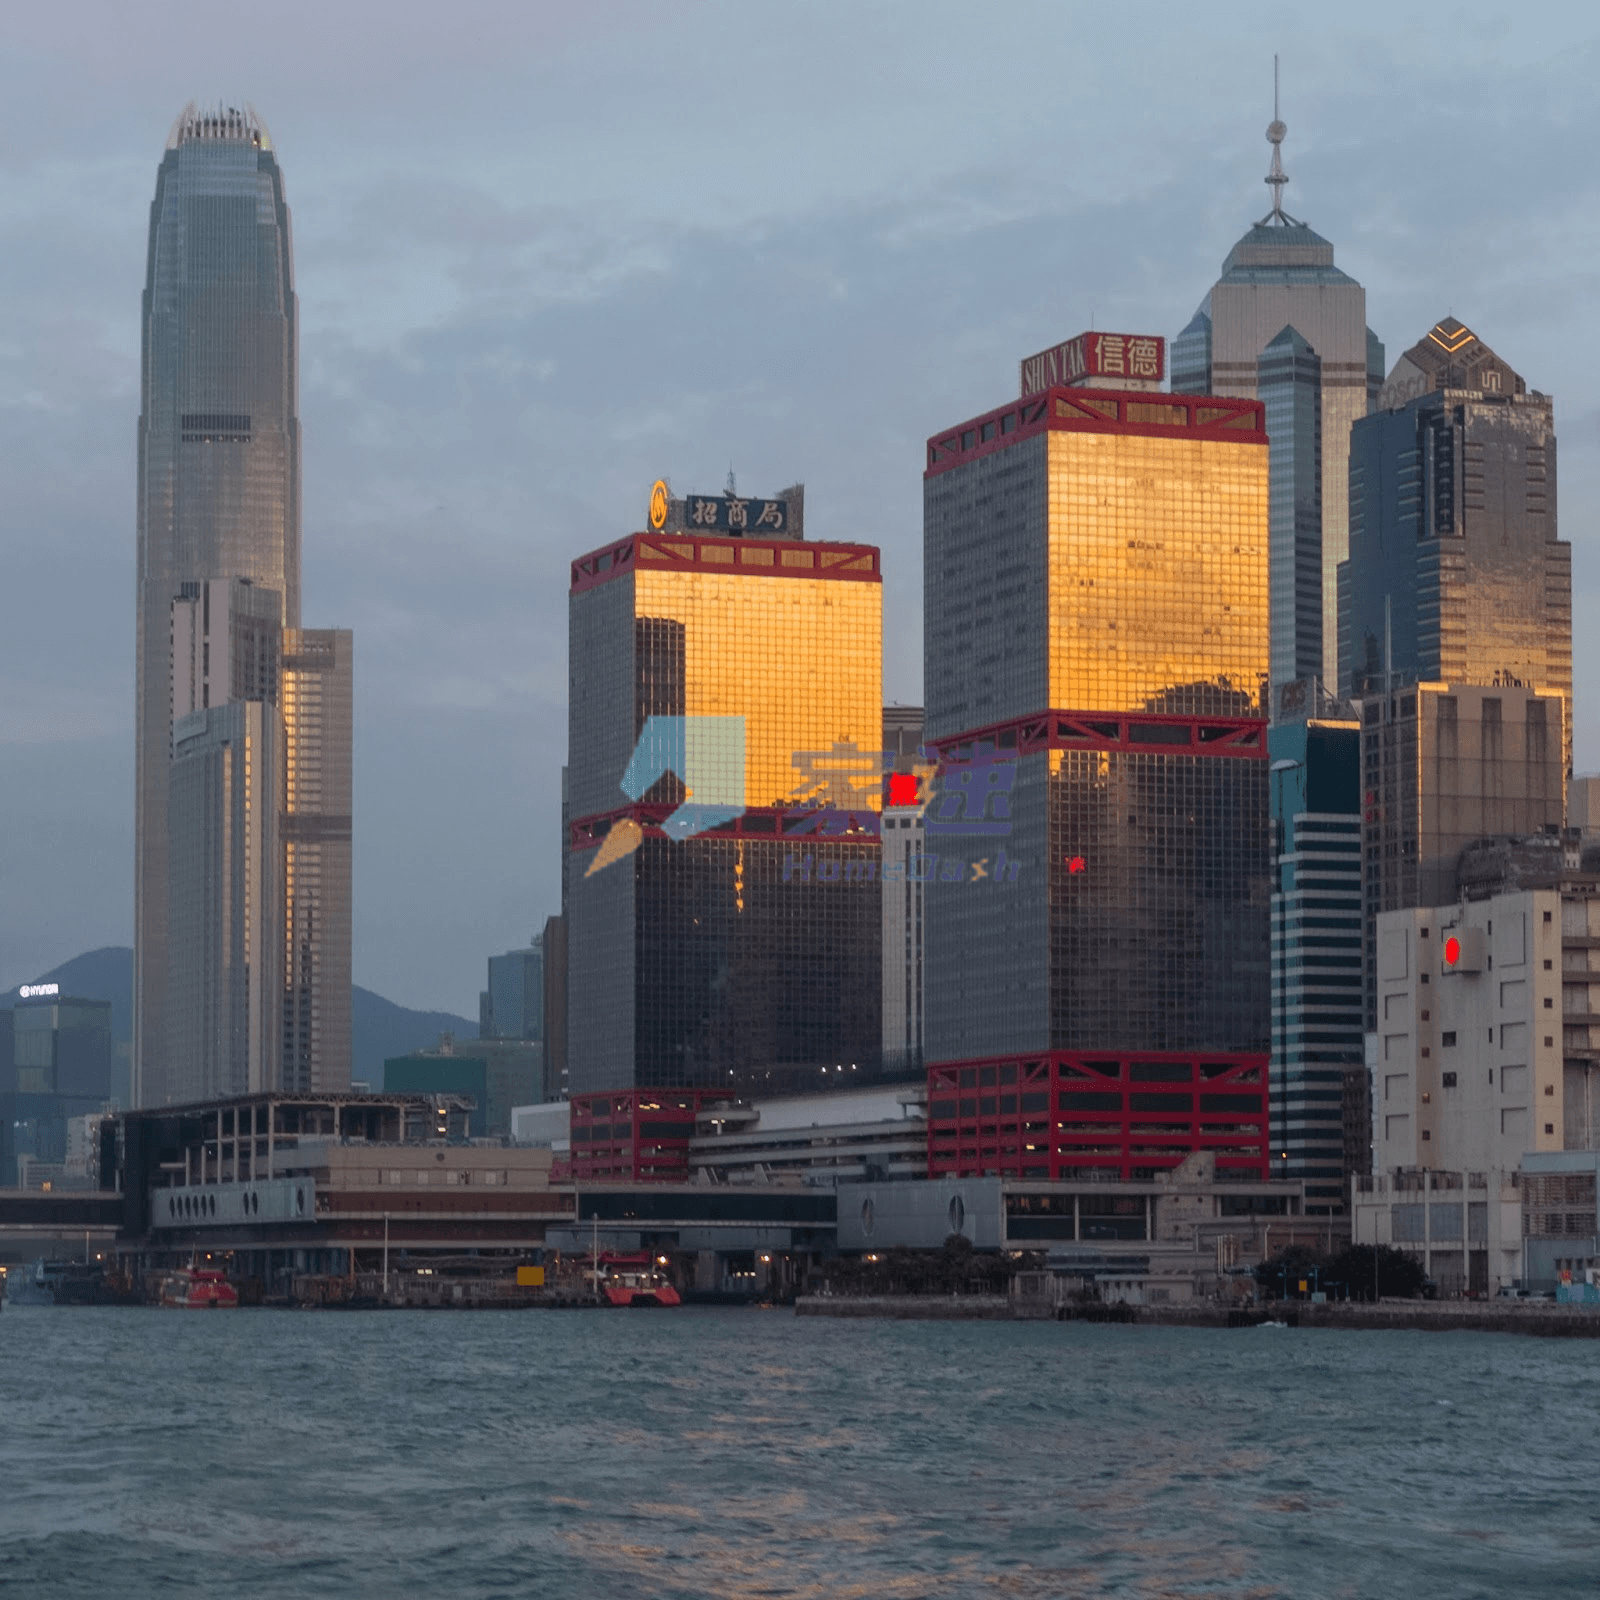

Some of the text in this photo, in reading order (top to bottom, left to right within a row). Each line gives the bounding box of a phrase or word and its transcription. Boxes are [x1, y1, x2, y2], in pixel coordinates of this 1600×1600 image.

[1025, 337, 1086, 396] SHUN TAK
[1095, 335, 1158, 376] 信德
[693, 501, 783, 529] 招商局
